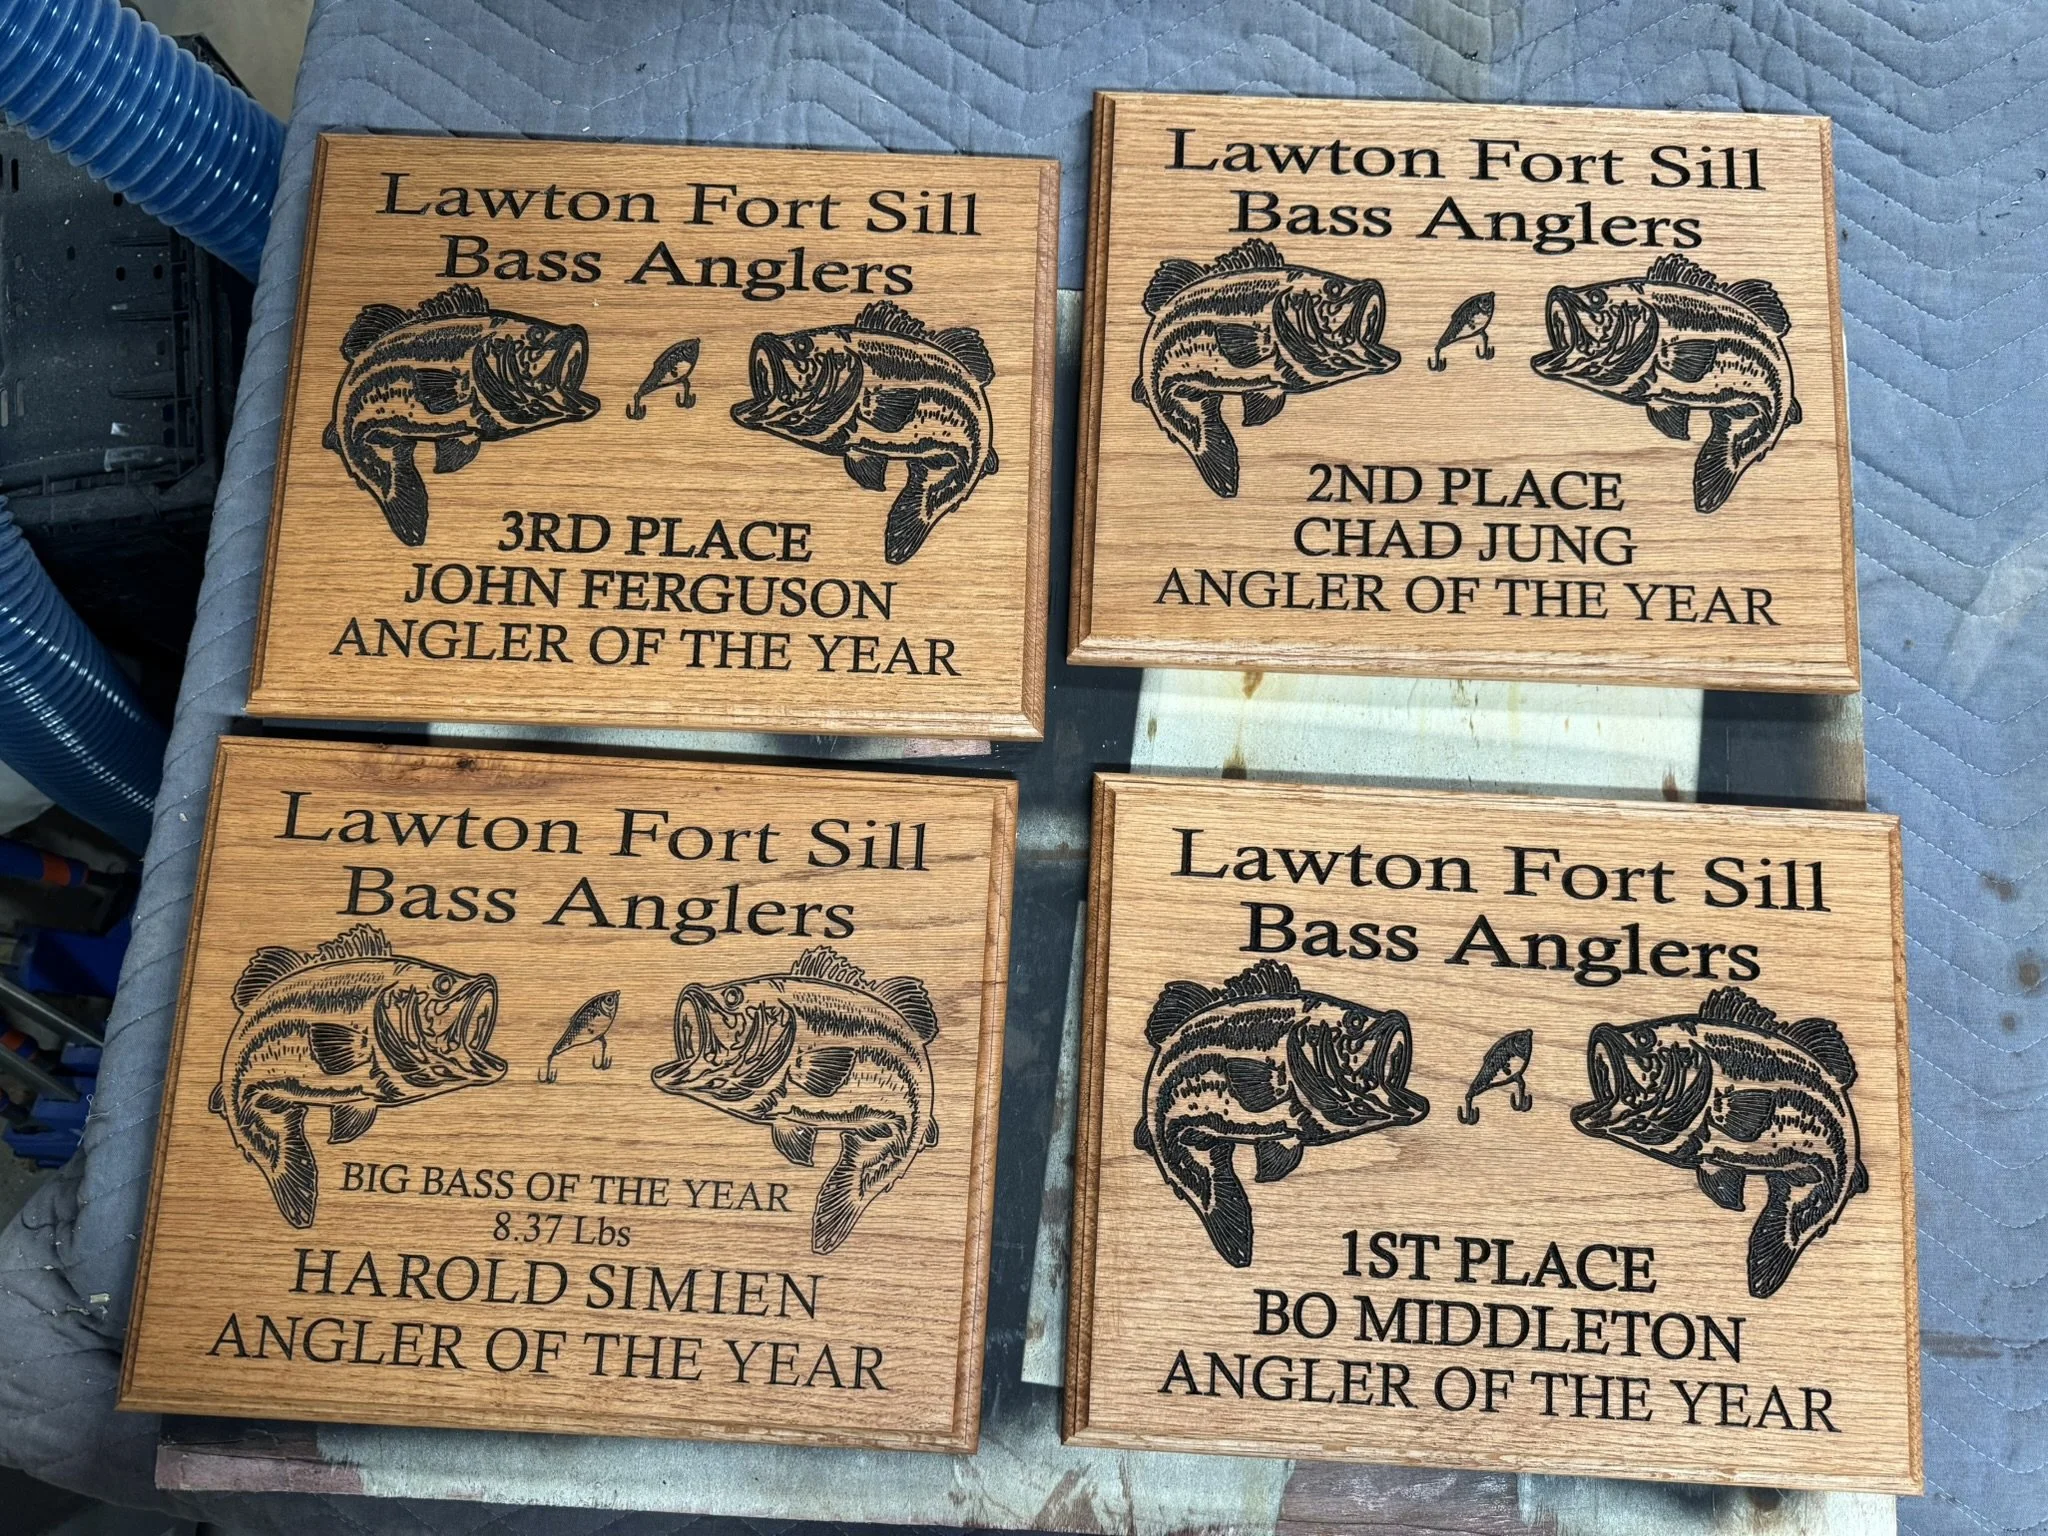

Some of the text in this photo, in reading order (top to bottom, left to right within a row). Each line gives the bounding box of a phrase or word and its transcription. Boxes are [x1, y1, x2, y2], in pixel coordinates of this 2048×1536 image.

[1164, 128, 1767, 191] Lawton Fort Sill
[375, 172, 982, 236] Lawton Fort Sill
[1228, 189, 1703, 256] Bass Anglers
[435, 234, 914, 302] Bass Anglers
[1306, 462, 1626, 512] 2ND PLACE
[497, 510, 814, 563] 3RD PLACE
[1293, 516, 1638, 567] CHAD JUNG
[403, 562, 899, 621] JOHN FERGUSON
[1152, 567, 1782, 626] ANGLER OF THE YEAR
[328, 616, 962, 677] ANGLER OF THE YEAR
[273, 790, 930, 872] Lawton Fort Sill
[1170, 827, 1832, 913] Lawton Fort Sill
[335, 865, 855, 946] Bass Anglers
[1238, 900, 1761, 988] Bass Anglers
[338, 1161, 793, 1213] BIG BASS OF THE YEAR
[492, 1211, 631, 1248] 8.37 Lbs
[1341, 1229, 1658, 1294] 1ST PLACE
[287, 1247, 825, 1320] HAROLD SIMIEN
[205, 1312, 891, 1391] ANGLER OF THE YEAR
[1252, 1288, 1747, 1364] BO MIDDLETON
[1156, 1349, 1842, 1434] ANGLER OF THE YEAR
